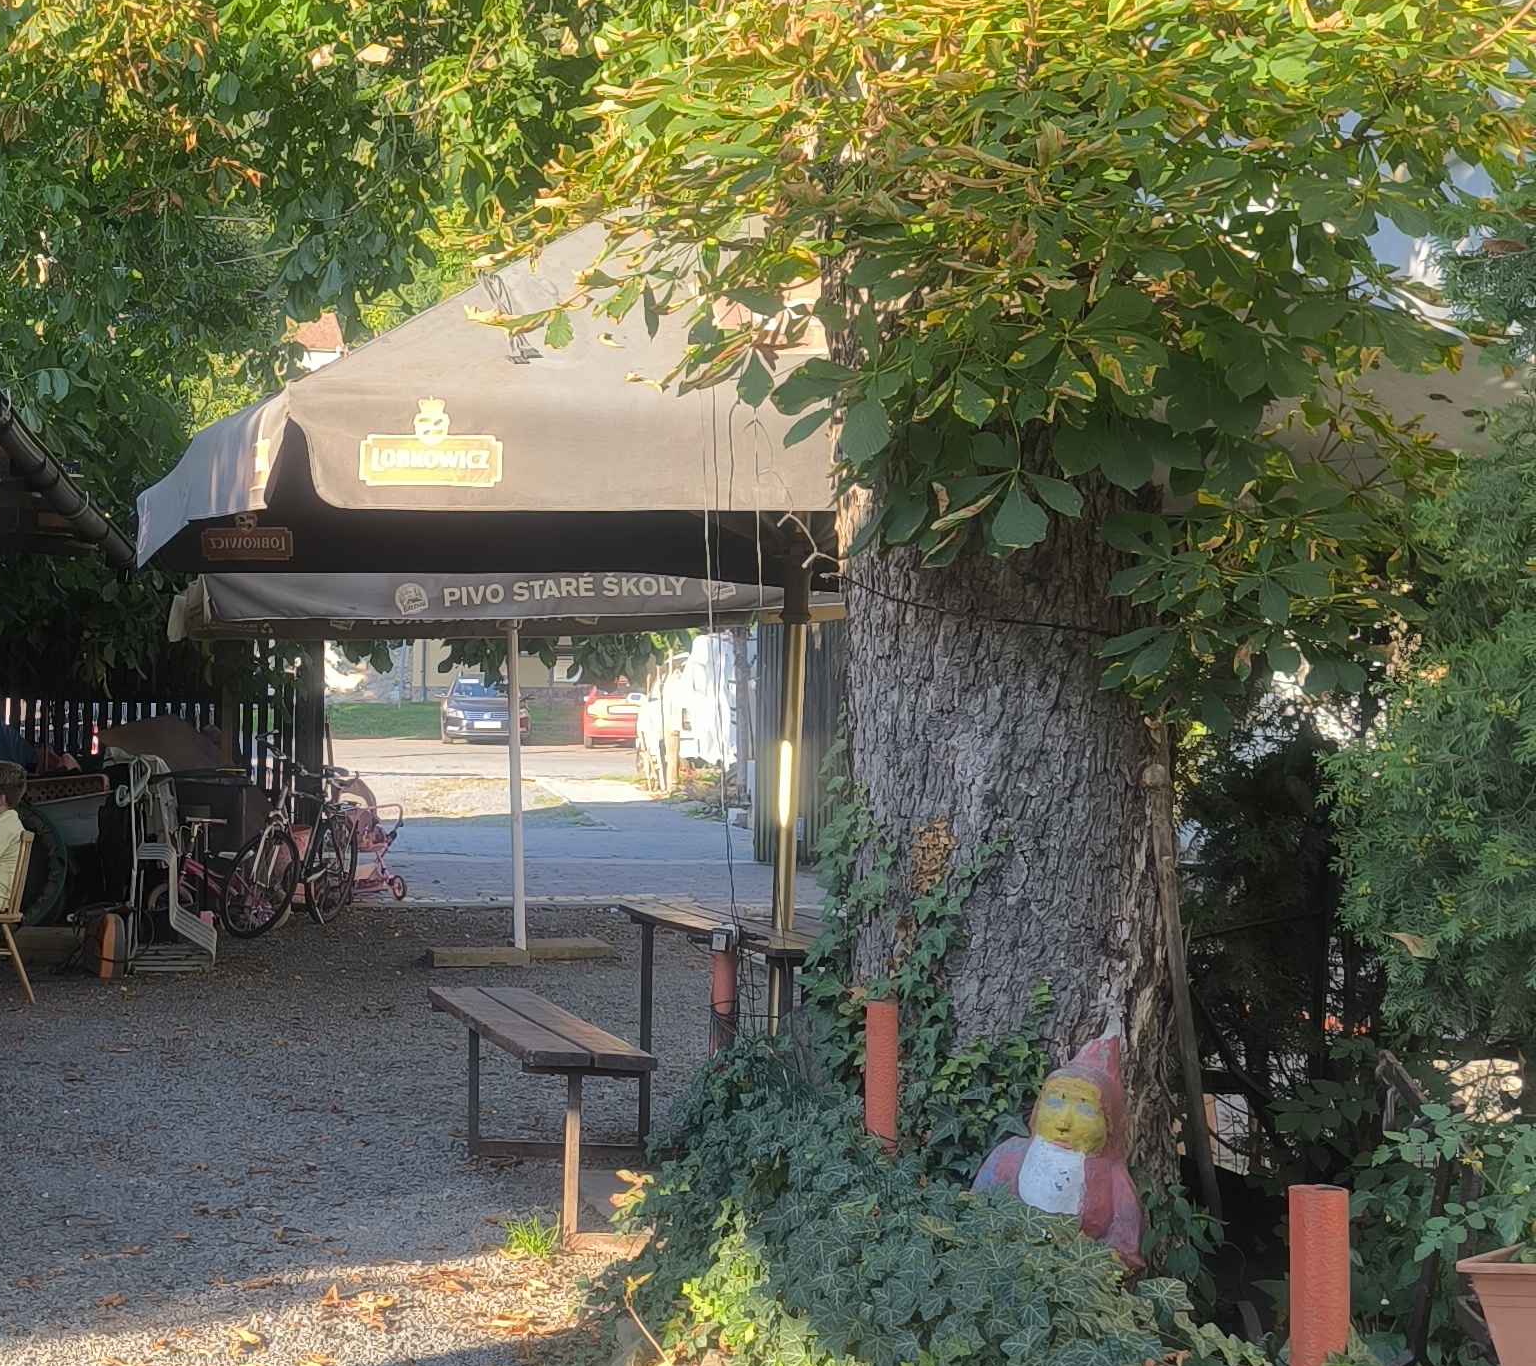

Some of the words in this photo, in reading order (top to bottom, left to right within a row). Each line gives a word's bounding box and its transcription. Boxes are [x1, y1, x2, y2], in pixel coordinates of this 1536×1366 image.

[371, 446, 491, 472] LOBKOWICZ
[443, 583, 504, 607] PIVO
[512, 572, 596, 602] STARÉ
[602, 572, 687, 597] ŠKOLY
